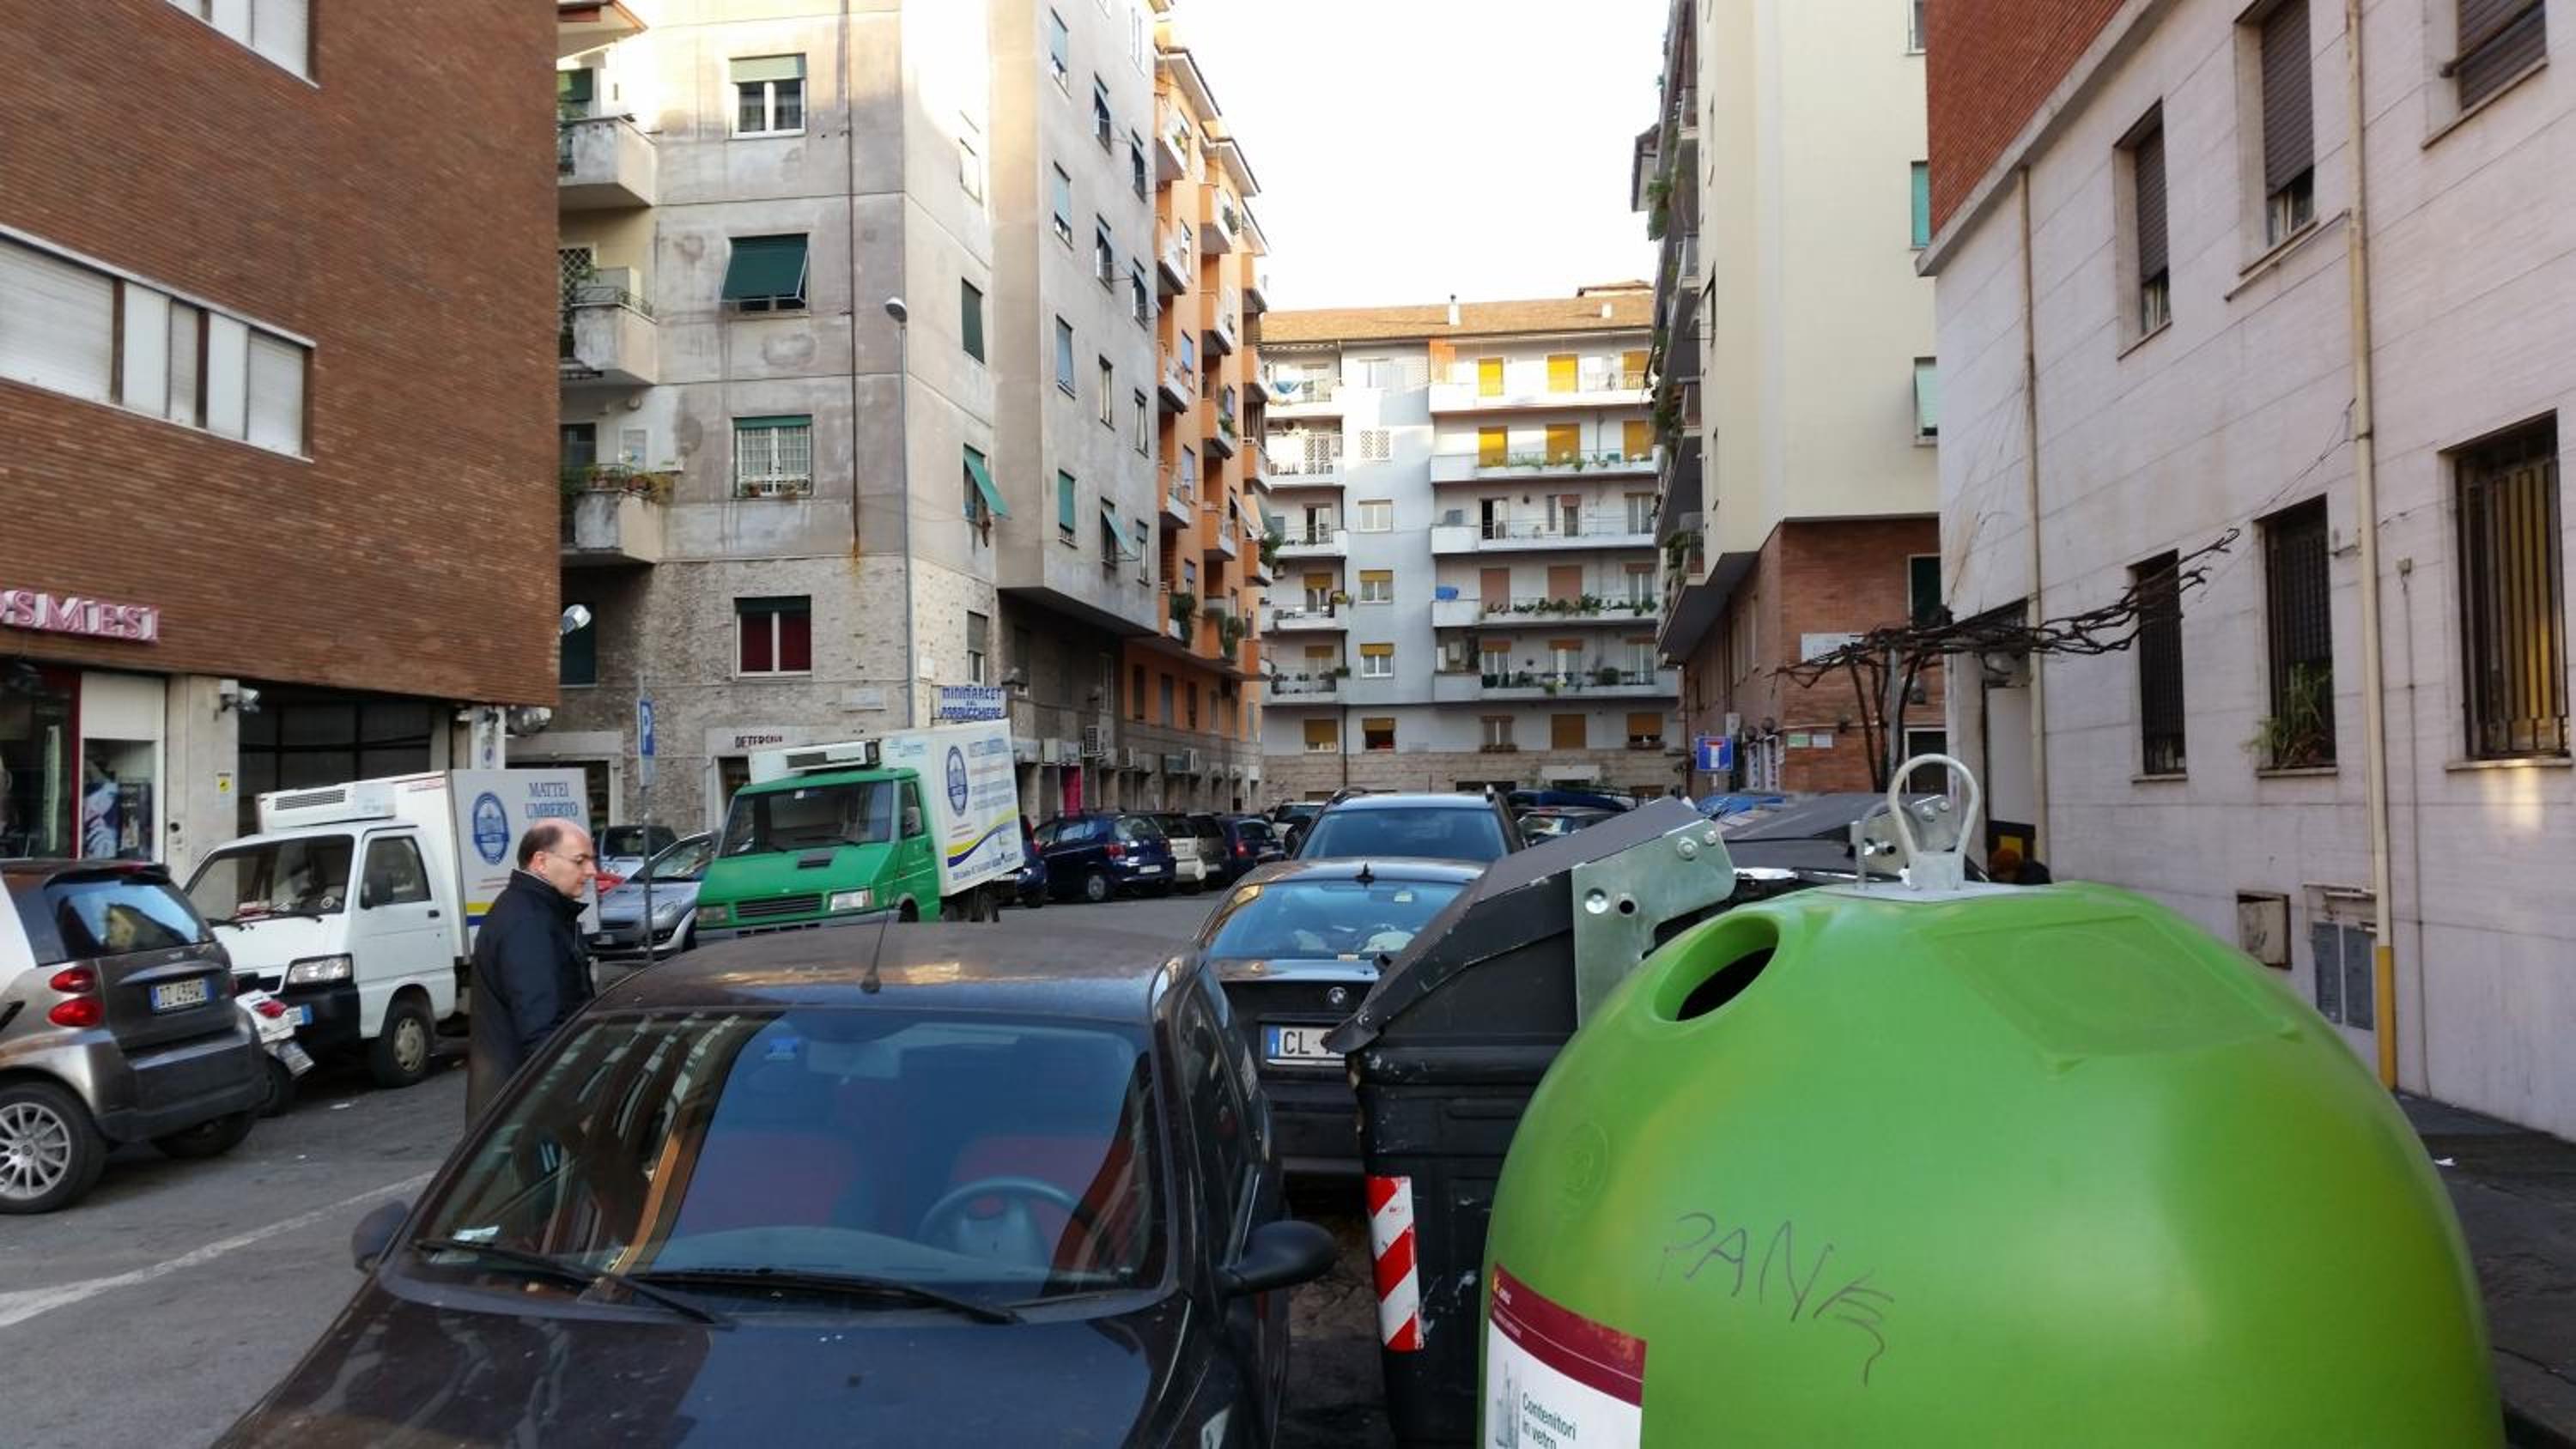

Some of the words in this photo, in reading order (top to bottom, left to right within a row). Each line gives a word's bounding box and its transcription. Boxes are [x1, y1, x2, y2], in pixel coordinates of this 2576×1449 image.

[641, 705, 652, 751] P
[528, 782, 569, 797] MATTEI
[525, 801, 579, 818] UMBERTO
[1522, 1391, 1577, 1441] Contenitori
